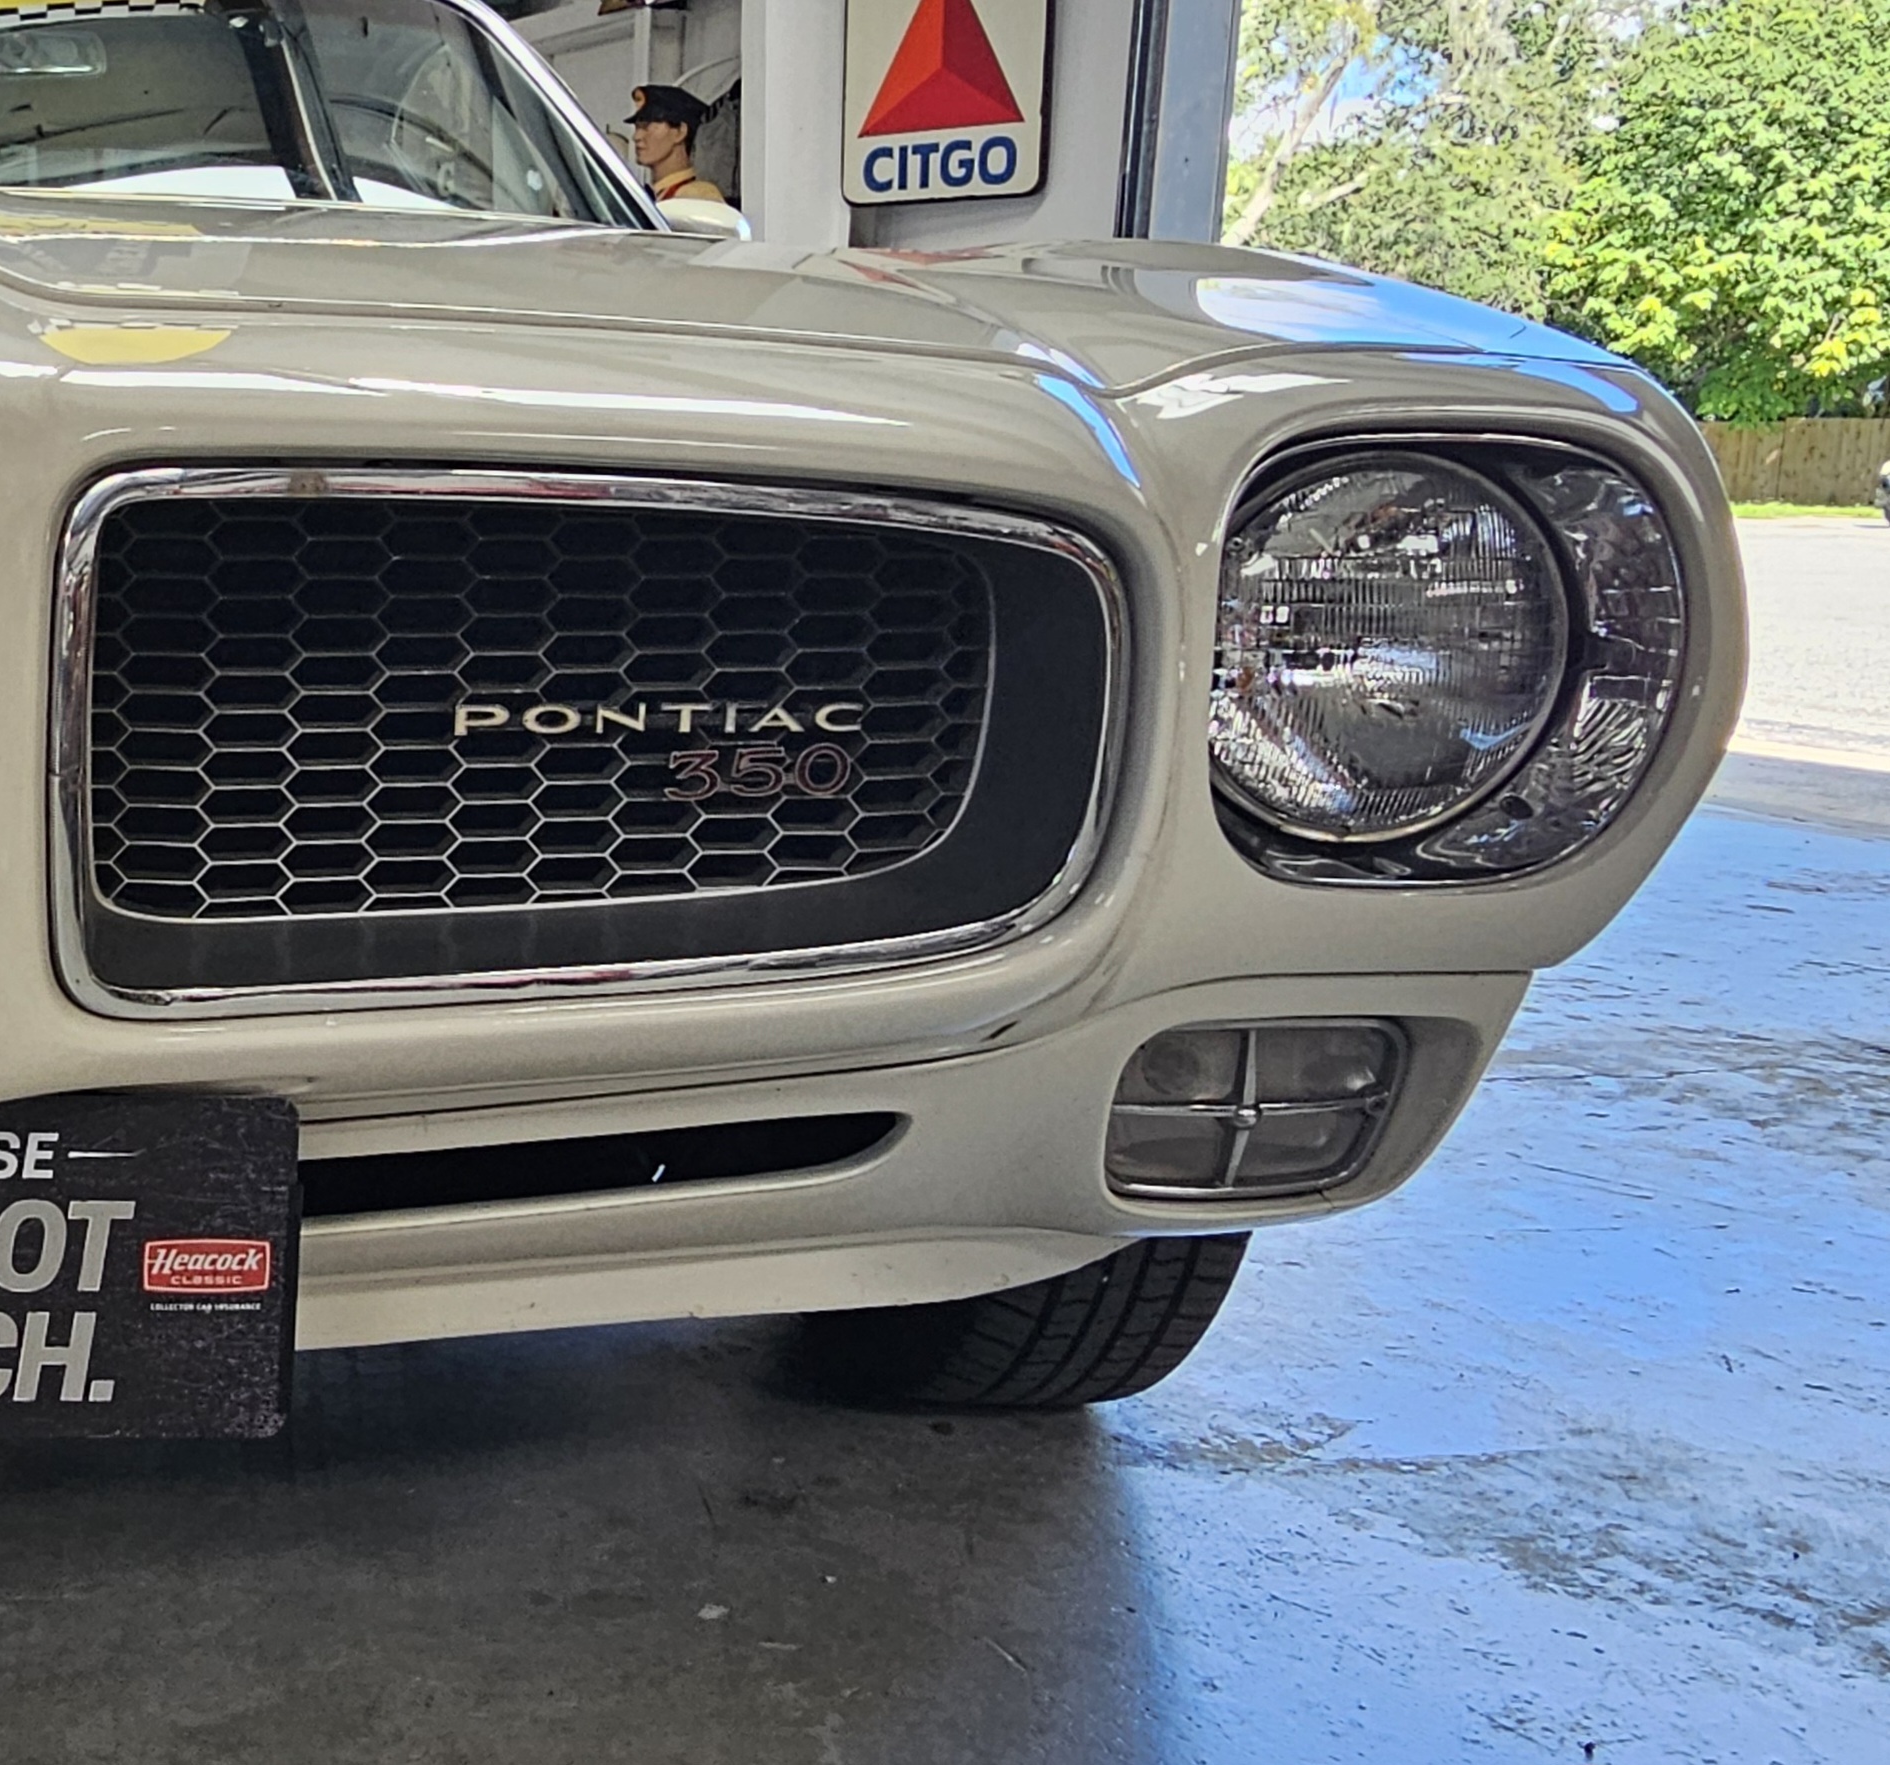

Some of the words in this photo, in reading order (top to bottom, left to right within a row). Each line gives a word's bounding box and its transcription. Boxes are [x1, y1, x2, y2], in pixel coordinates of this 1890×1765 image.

[863, 136, 1017, 192] CITGO
[454, 703, 863, 736] PONTIAC
[664, 743, 851, 801] 350
[149, 1248, 263, 1274] Heacock
[171, 1275, 242, 1285] CLASSIC
